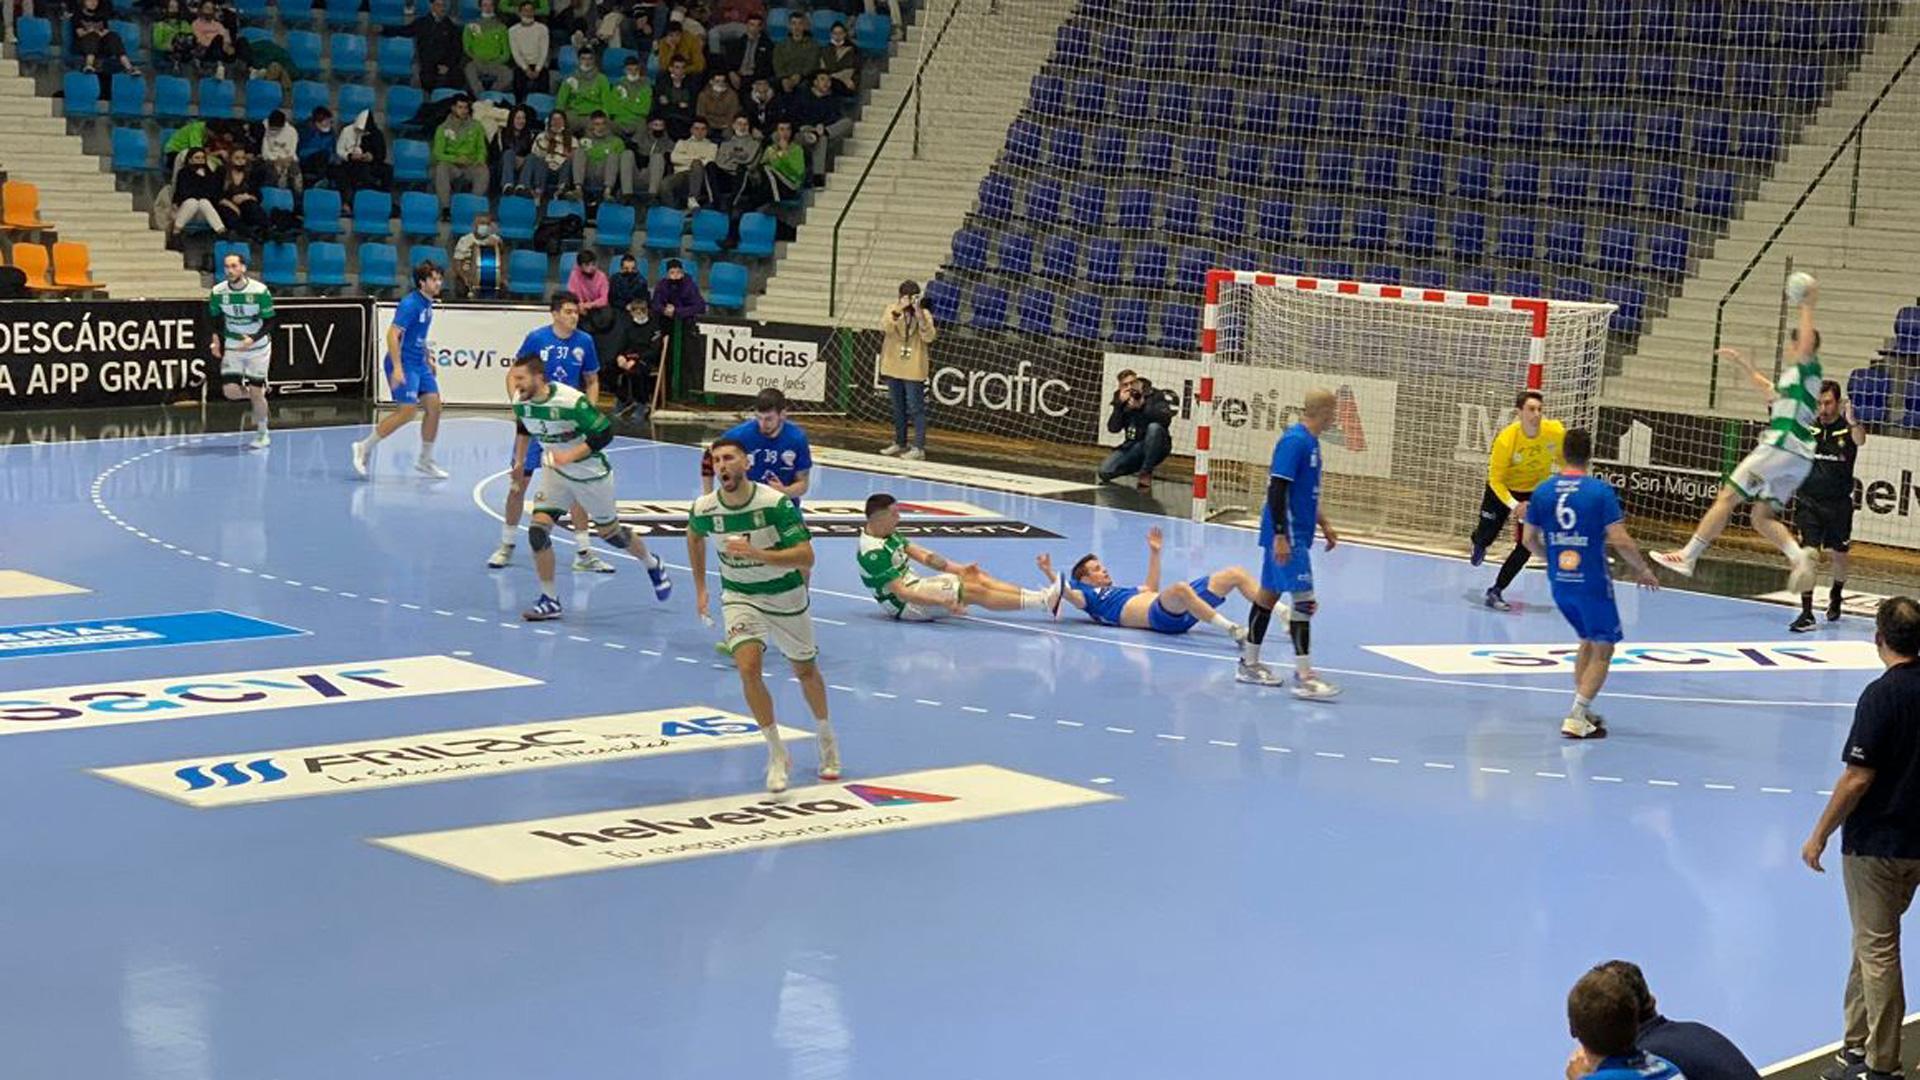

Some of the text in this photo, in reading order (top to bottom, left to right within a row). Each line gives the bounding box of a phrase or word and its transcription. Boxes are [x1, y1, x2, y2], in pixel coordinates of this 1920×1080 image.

[280, 323, 335, 365] TV
[556, 347, 569, 359] 37
[711, 338, 808, 368] Noticias
[26, 363, 90, 395] APP
[100, 359, 206, 393] GRATIS
[711, 368, 737, 383] Eres
[741, 372, 753, 386] lo
[756, 376, 779, 389] que
[1630, 471, 1660, 492] San
[1556, 493, 1576, 530] 6
[661, 715, 760, 738] 45
[532, 800, 863, 847] helvetia
[599, 814, 909, 861] Tu aseguradora suiza
